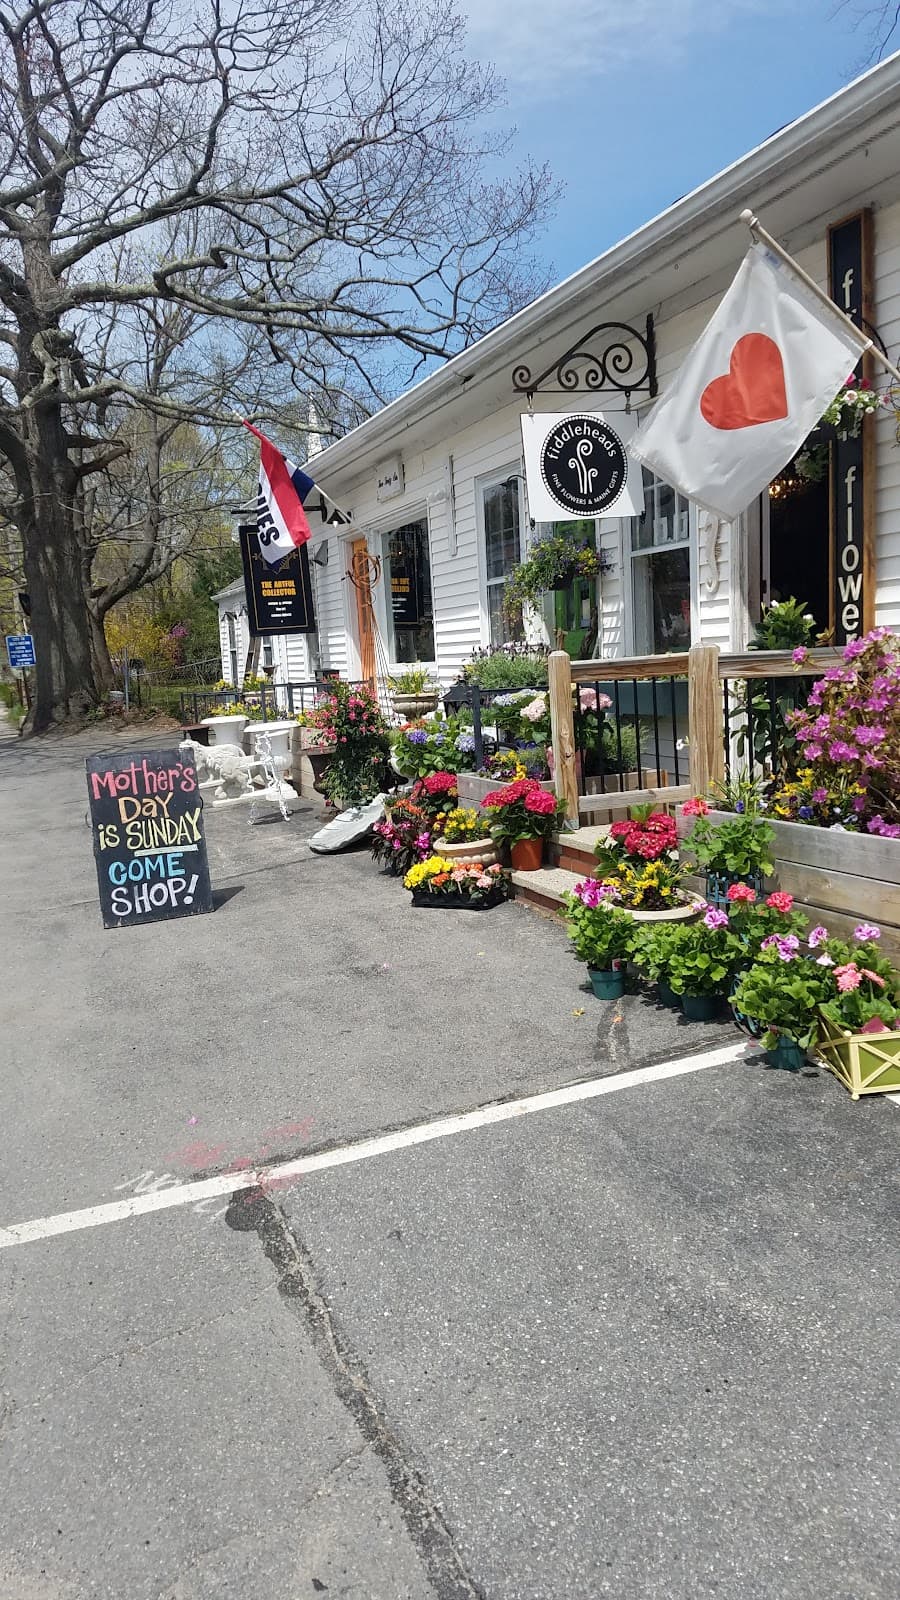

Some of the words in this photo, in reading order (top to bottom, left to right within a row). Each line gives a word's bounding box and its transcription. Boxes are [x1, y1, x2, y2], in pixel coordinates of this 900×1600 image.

[547, 421, 617, 460] fiddleheads
[560, 488, 587, 505] FLOWERS
[608, 470, 619, 489] GIFTS
[98, 823, 120, 851] is
[125, 807, 202, 850] SUNDAY
[108, 852, 186, 886] COME
[110, 874, 200, 917] SHOP!
